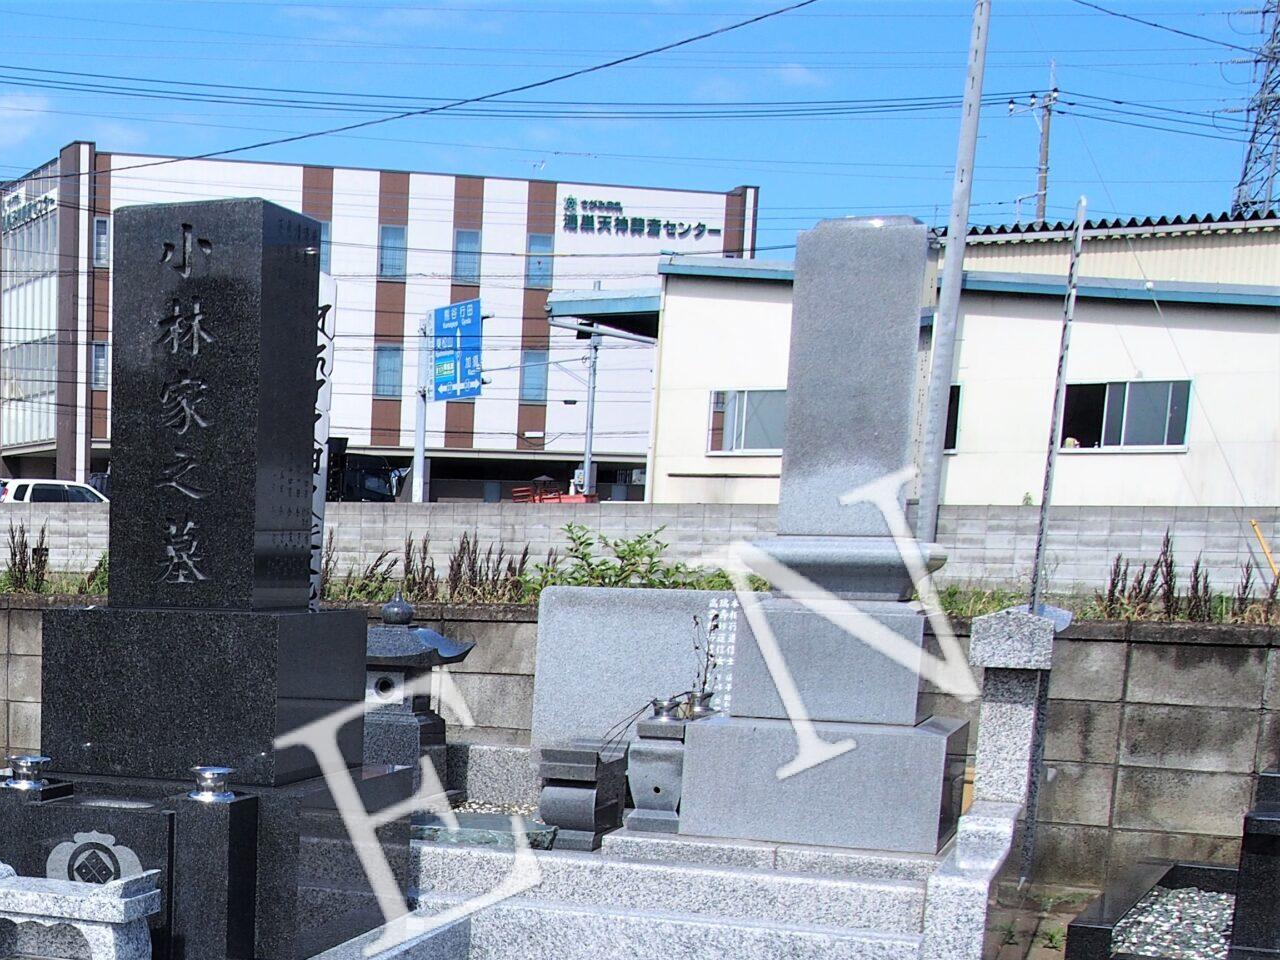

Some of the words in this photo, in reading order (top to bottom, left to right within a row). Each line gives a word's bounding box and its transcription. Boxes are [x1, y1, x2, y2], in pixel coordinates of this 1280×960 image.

[151, 222, 219, 585] 小林家之墓
